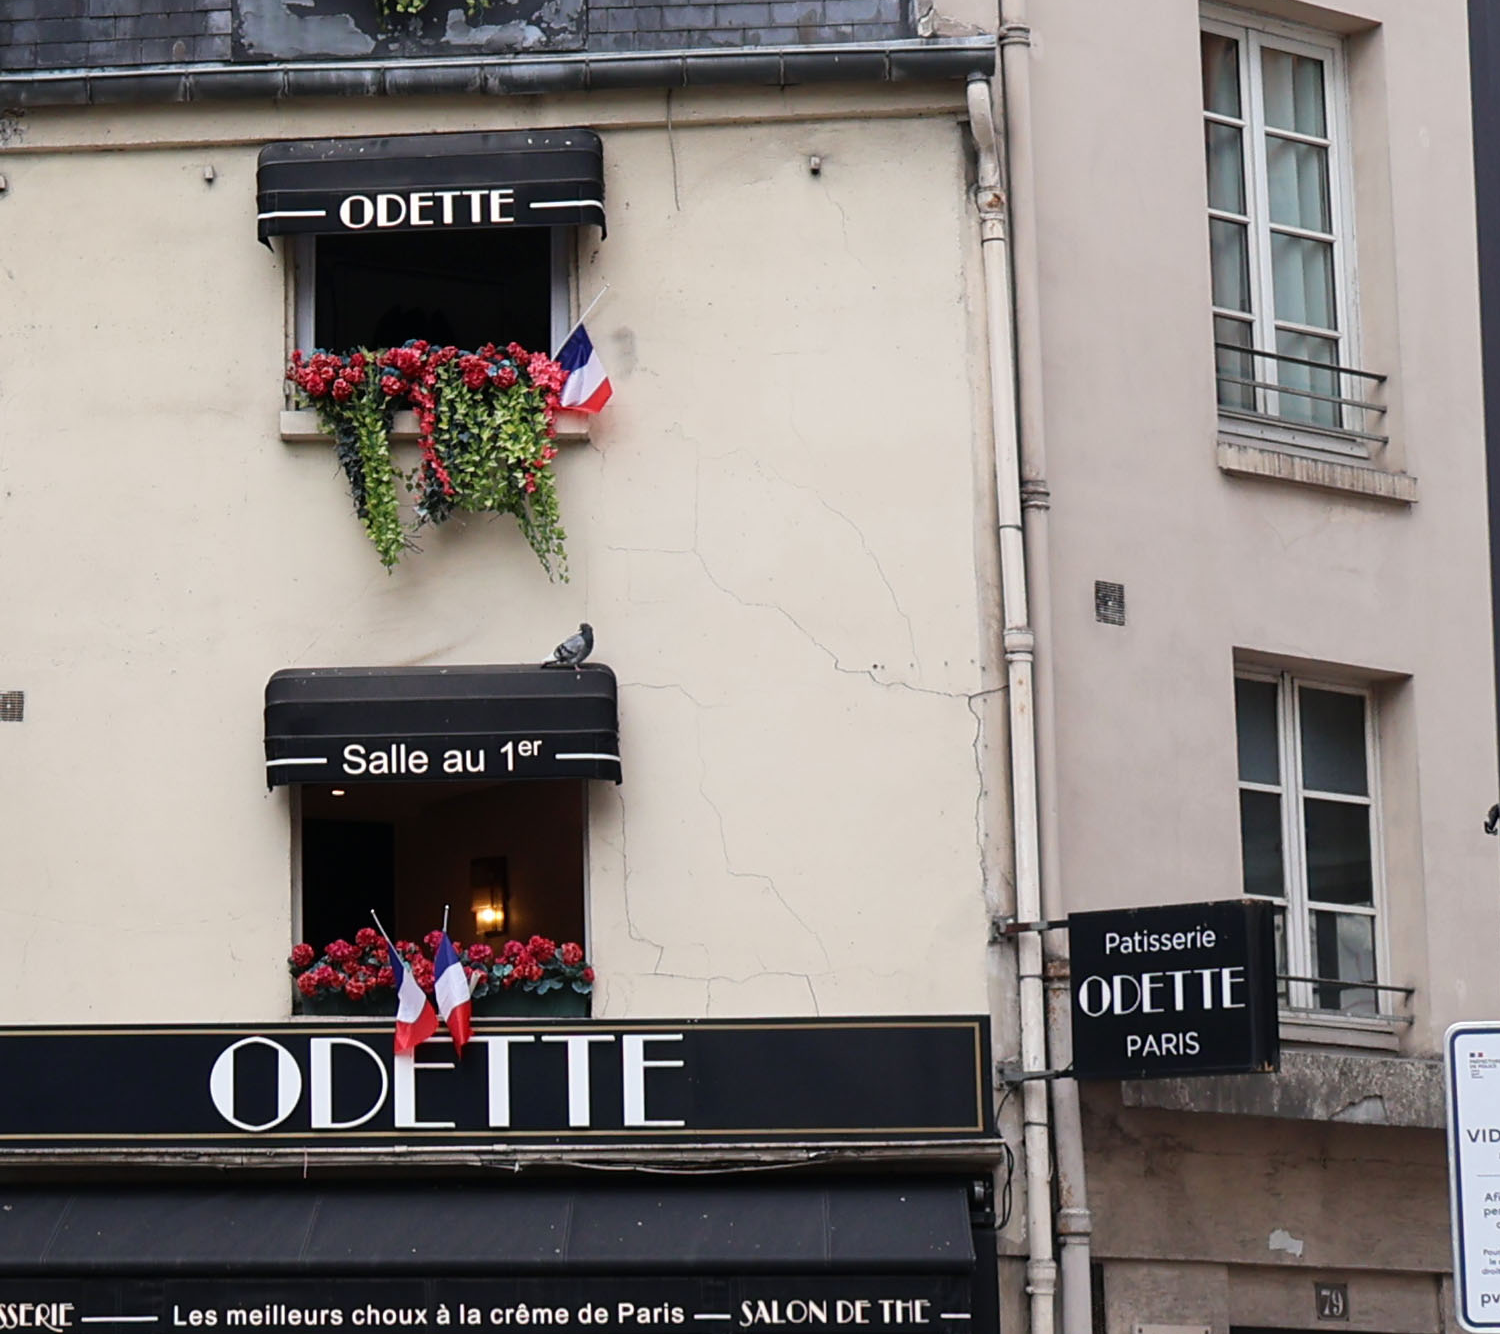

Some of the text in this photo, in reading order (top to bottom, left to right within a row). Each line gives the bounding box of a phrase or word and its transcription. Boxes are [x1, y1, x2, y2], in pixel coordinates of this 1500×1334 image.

[338, 189, 515, 229] ODETTE
[342, 737, 542, 776] Salle au 1er
[1105, 925, 1216, 955] Patisserie
[1078, 967, 1245, 1017] ODETTE
[1127, 1031, 1200, 1057] PARIS
[210, 1033, 684, 1131] ODETTE
[174, 1305, 218, 1326] Les
[227, 1304, 343, 1325] meilleurs
[352, 1304, 427, 1325] choux
[436, 1302, 450, 1324] à
[460, 1303, 482, 1324] la
[491, 1303, 569, 1324] crême
[578, 1303, 608, 1324] de
[619, 1303, 684, 1324] Paris
[740, 1300, 827, 1327] SALON
[836, 1300, 869, 1323] DE
[879, 1299, 930, 1324] THE
[1320, 1287, 1344, 1317] 79
